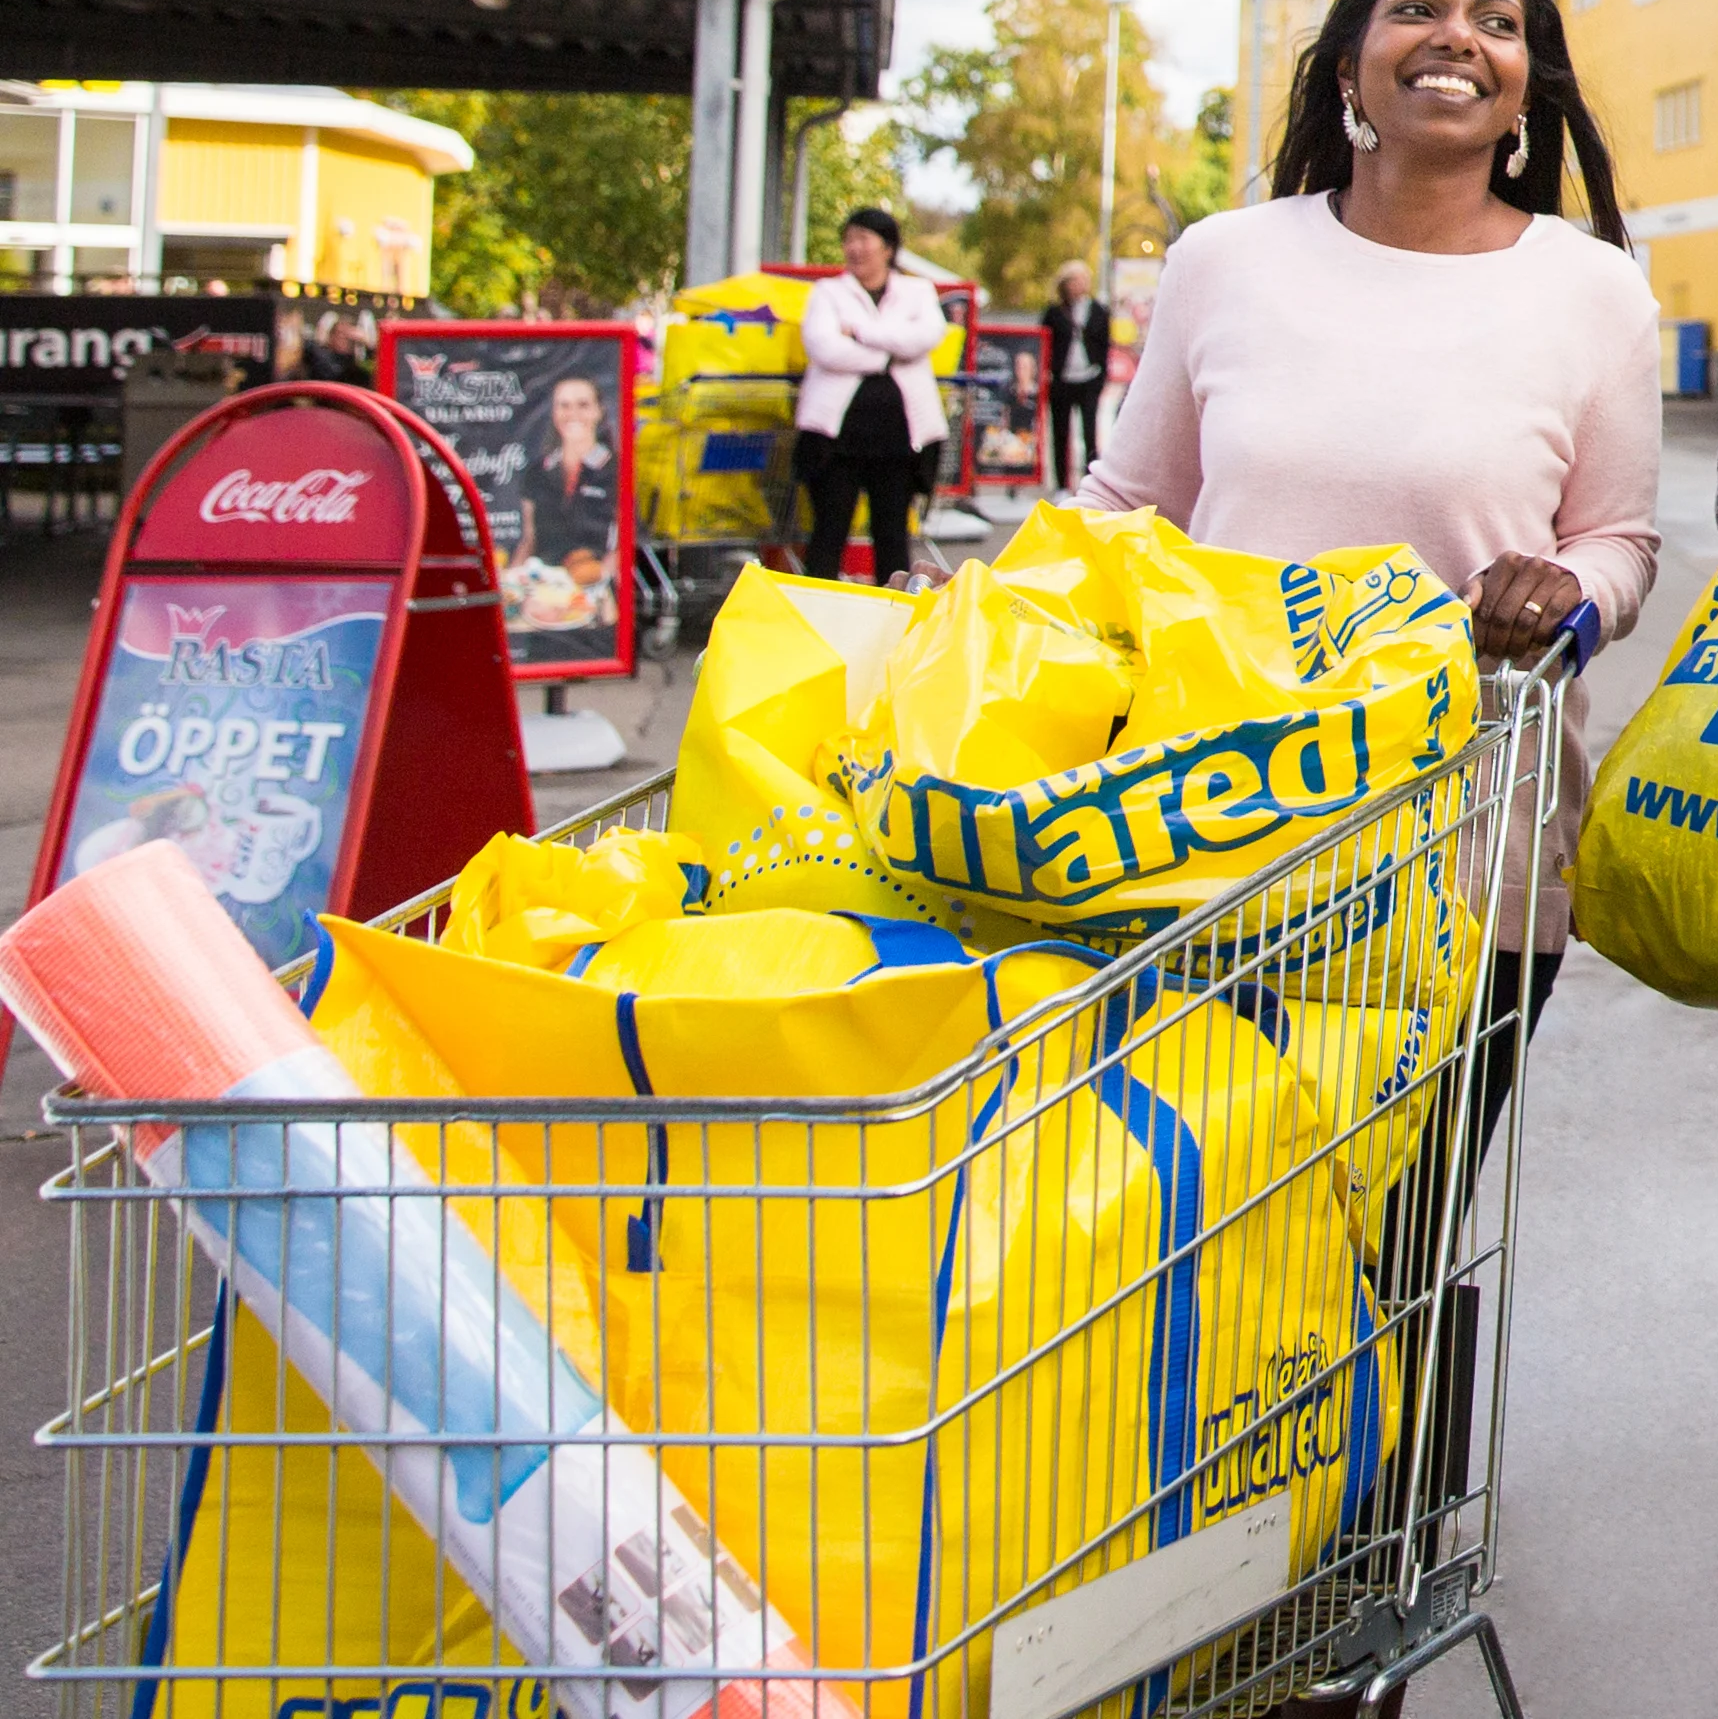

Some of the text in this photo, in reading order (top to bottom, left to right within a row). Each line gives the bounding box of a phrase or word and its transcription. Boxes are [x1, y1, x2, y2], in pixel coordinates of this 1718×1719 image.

[0, 326, 152, 382] rang
[412, 371, 527, 406] RASTA
[161, 636, 334, 691] RASTA
[118, 702, 346, 783] ÖPPET
